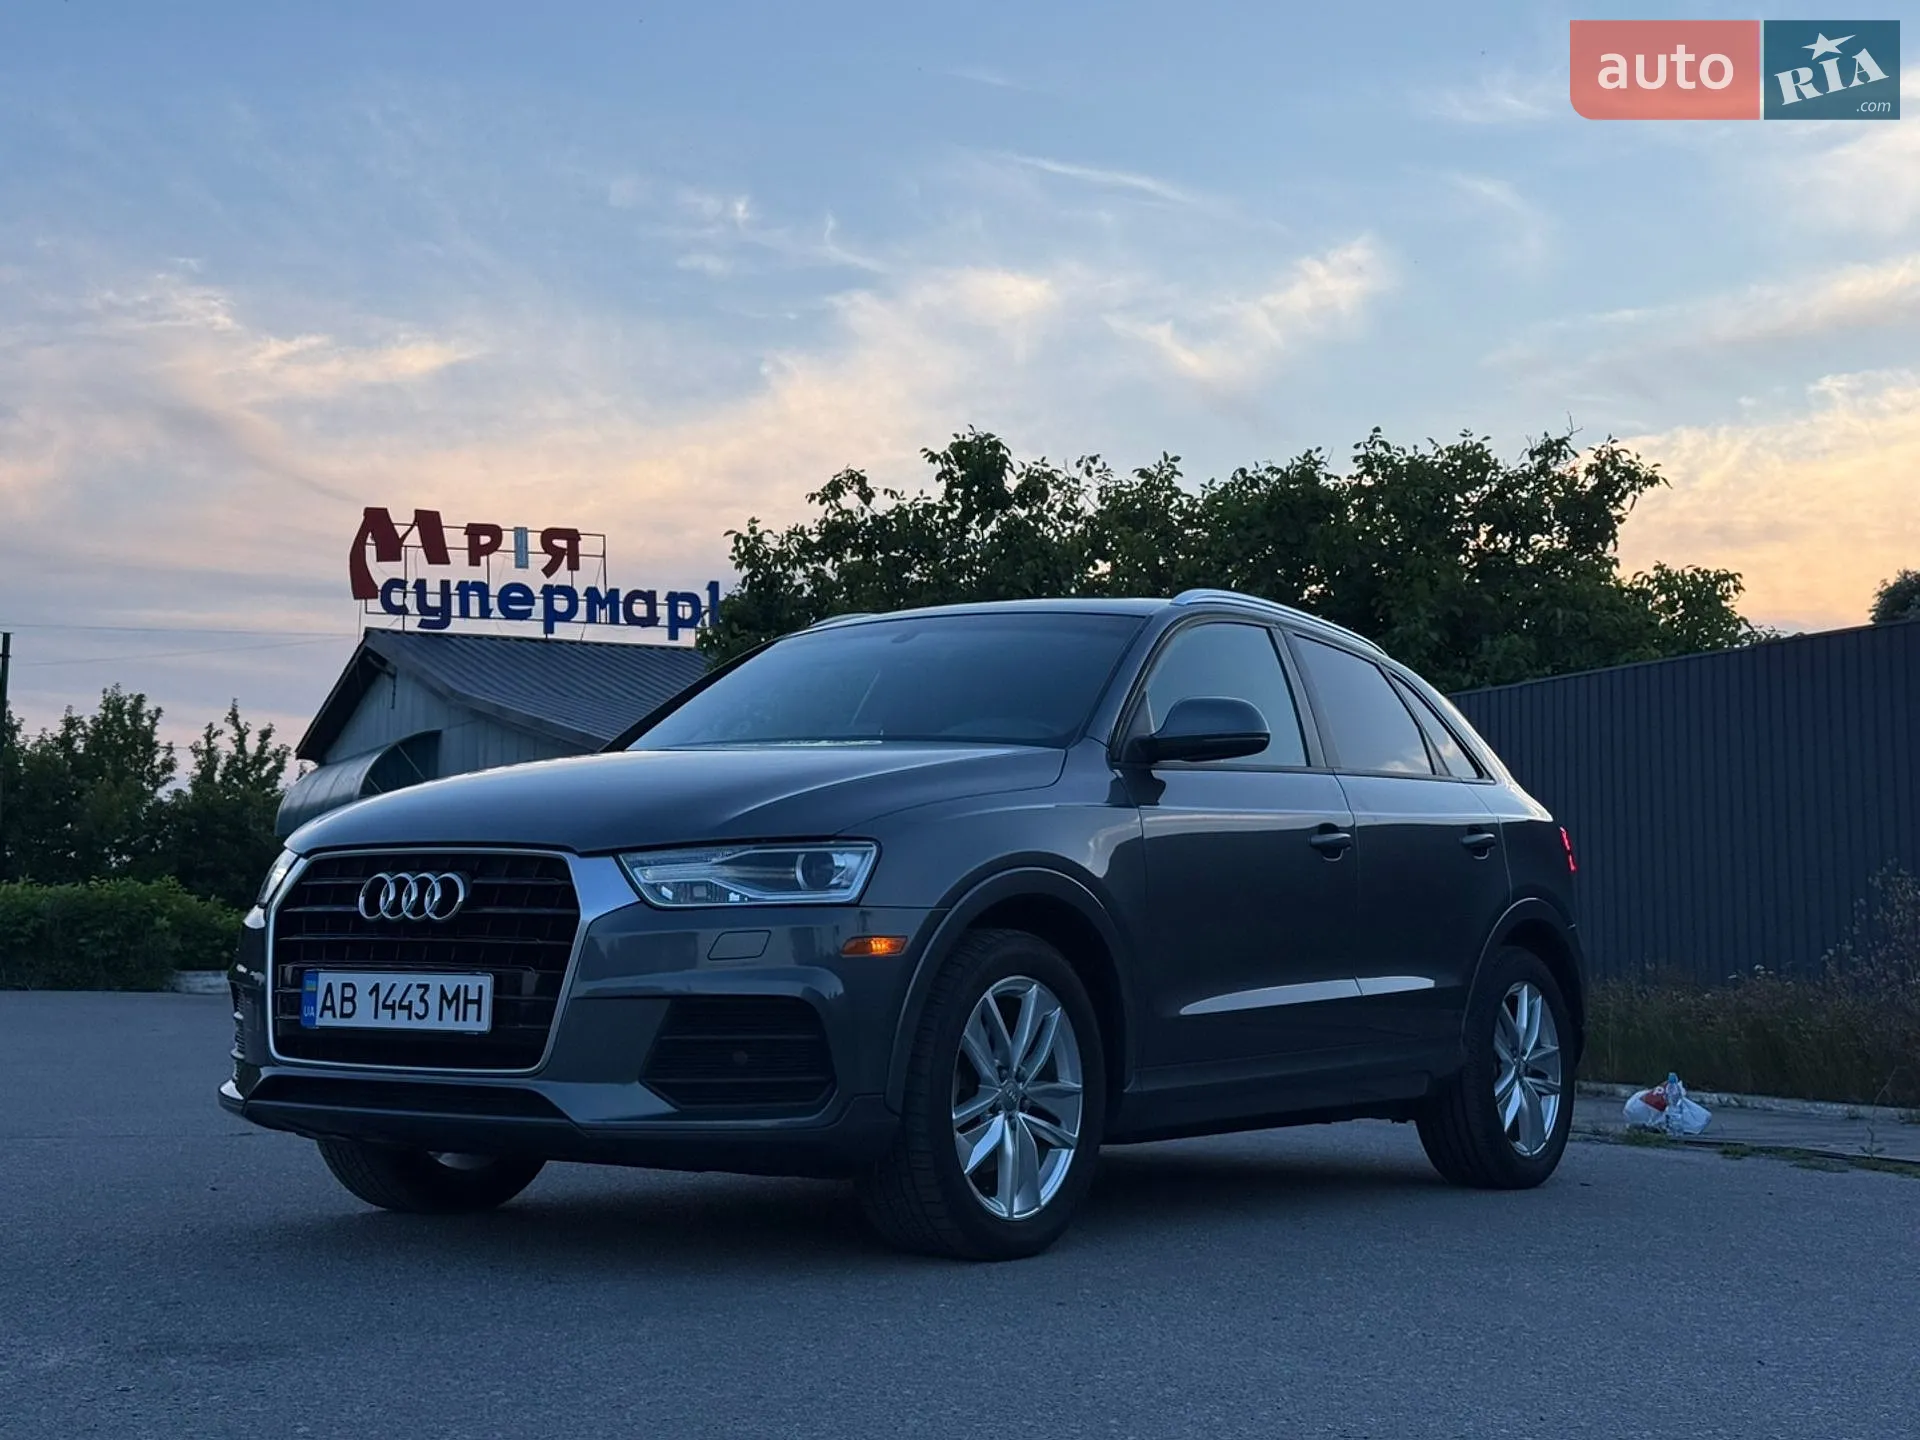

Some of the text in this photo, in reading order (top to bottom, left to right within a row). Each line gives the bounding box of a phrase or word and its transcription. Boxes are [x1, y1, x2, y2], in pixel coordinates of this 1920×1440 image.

[303, 1005, 315, 1018] UA
[319, 982, 483, 1022] AB 1443 MH
